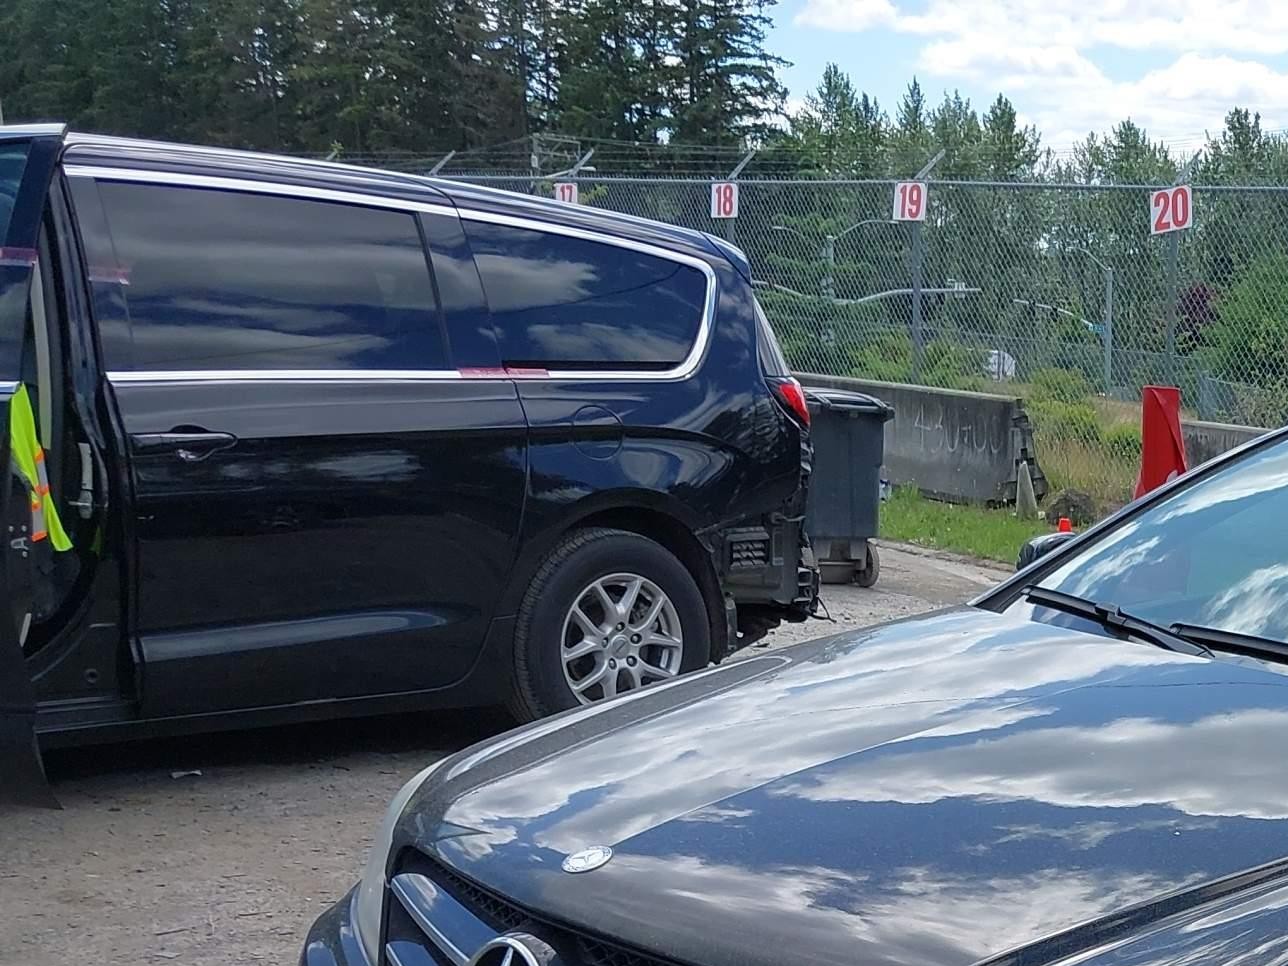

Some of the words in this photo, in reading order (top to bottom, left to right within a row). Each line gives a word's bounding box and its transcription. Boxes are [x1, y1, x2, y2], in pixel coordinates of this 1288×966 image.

[560, 184, 573, 202] 17
[716, 185, 733, 215] 18
[900, 184, 923, 219] 19
[1155, 188, 1189, 231] 20
